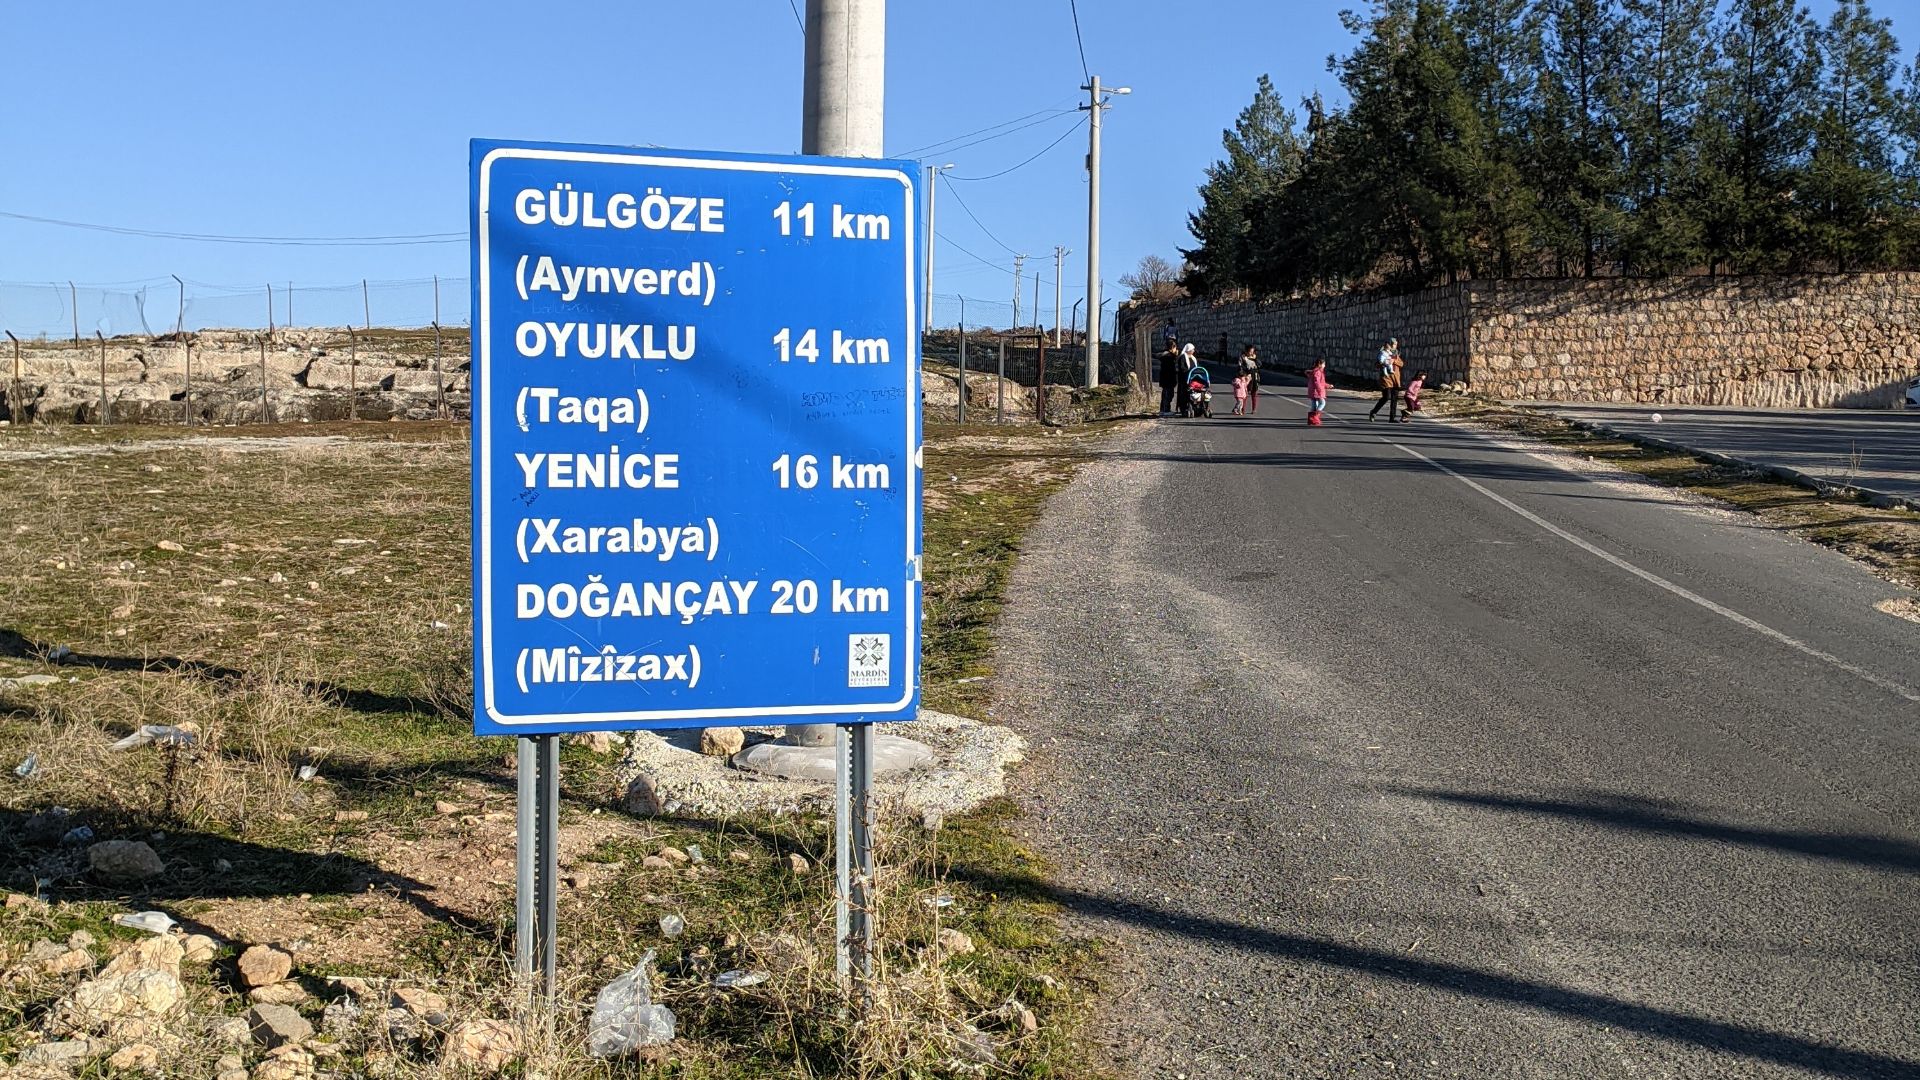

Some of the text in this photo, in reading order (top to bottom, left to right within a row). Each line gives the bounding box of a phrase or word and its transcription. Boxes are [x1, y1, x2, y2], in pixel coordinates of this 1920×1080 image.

[516, 183, 890, 240] GÜLGÖZE 11 km
[516, 255, 716, 306] (Aynverd)
[515, 321, 890, 364] OYUKLU 14 km
[516, 387, 649, 433] (Taqa)
[515, 445, 890, 489] YENİCE 16 km
[516, 518, 719, 563] (Xarabya)
[517, 575, 889, 625] DOĞANÇAY 20 km
[516, 644, 701, 693] (Mîzîzax)
[850, 669, 887, 677] MARDİN
